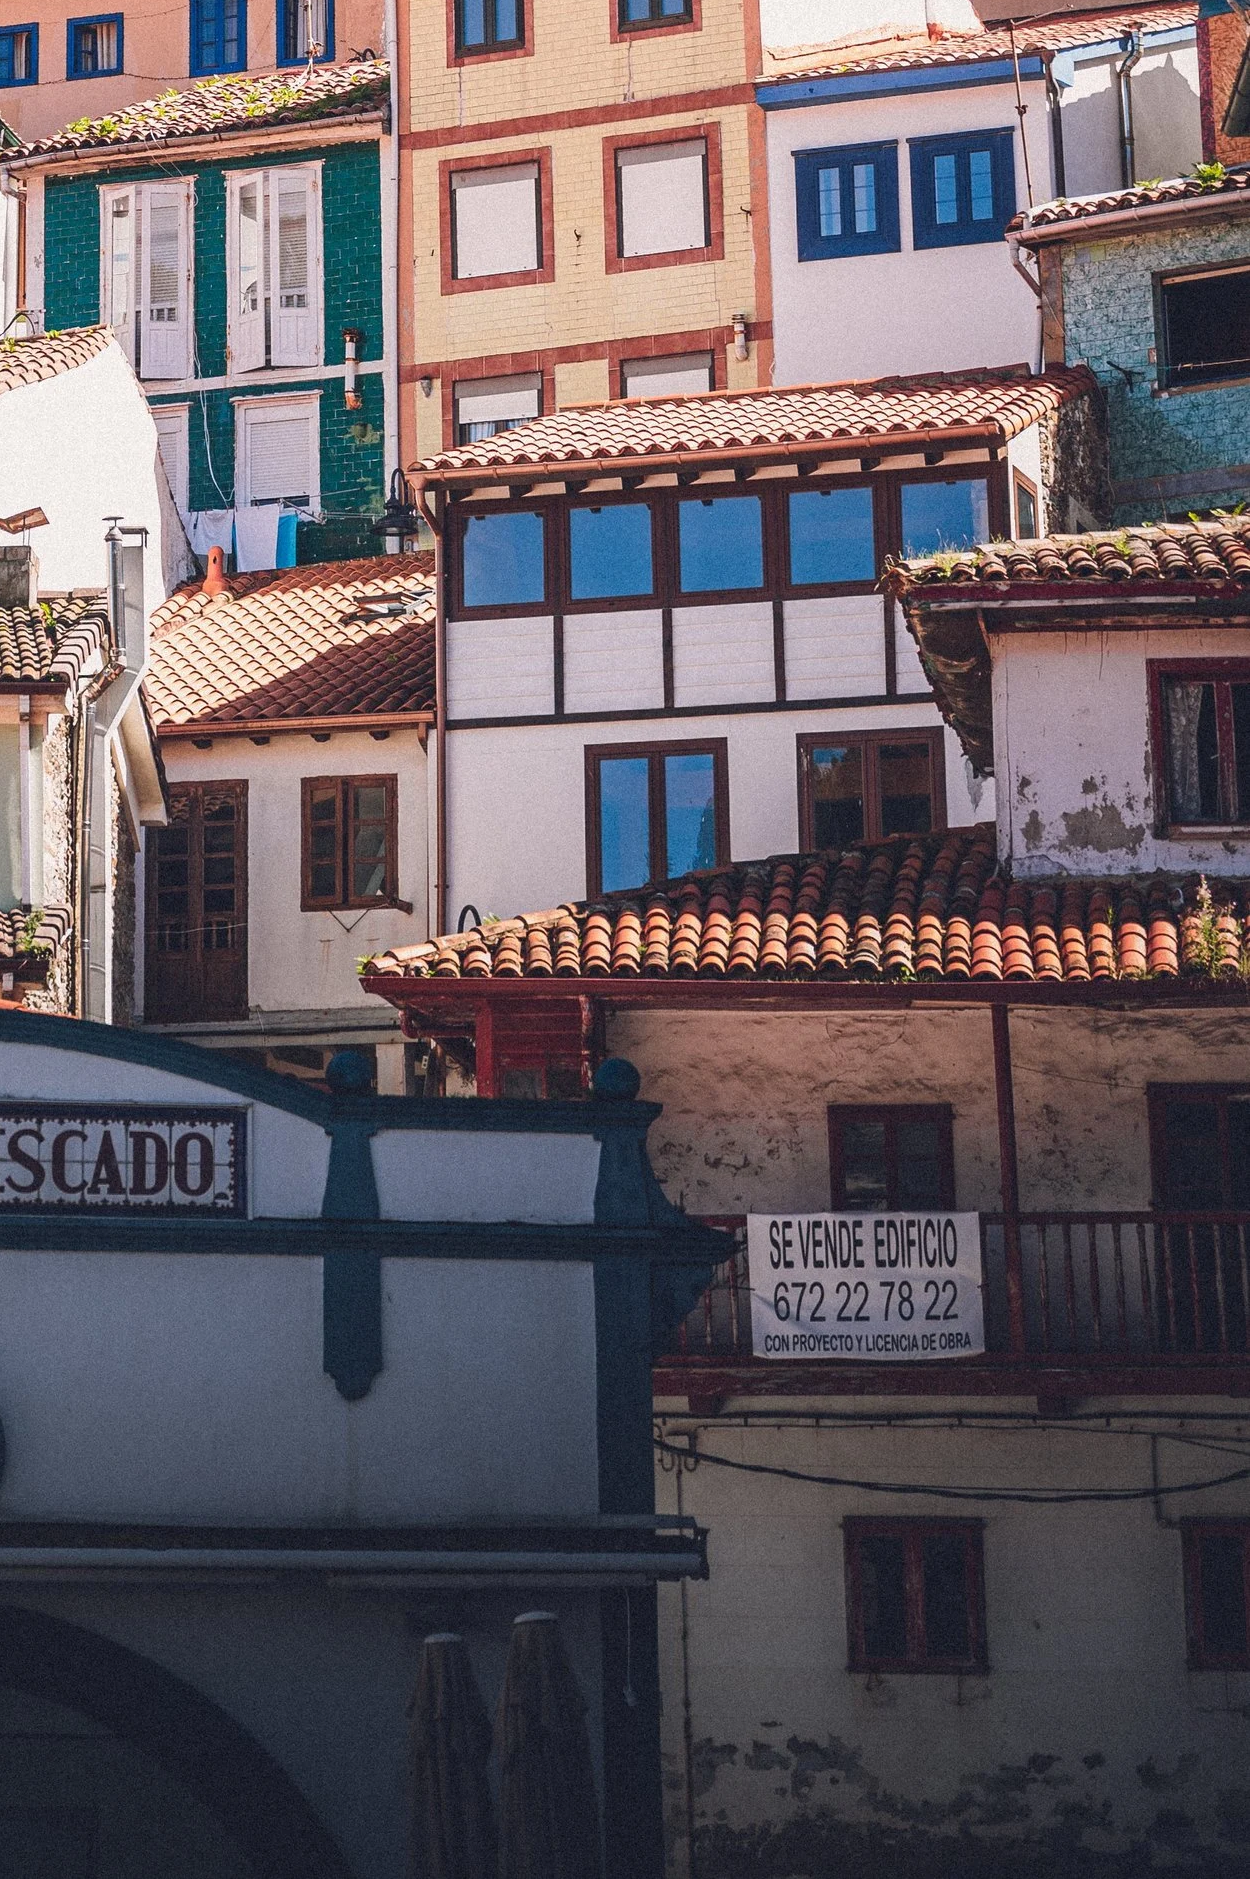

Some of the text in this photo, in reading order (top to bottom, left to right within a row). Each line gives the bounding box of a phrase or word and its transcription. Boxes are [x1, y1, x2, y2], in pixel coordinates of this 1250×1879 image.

[769, 1218, 958, 1270] SE VENDE EDIFICIO
[773, 1279, 959, 1322] 672 22 78 22
[764, 1332, 972, 1353] CON PROYECTO Y LICENCIA DE OBRA
